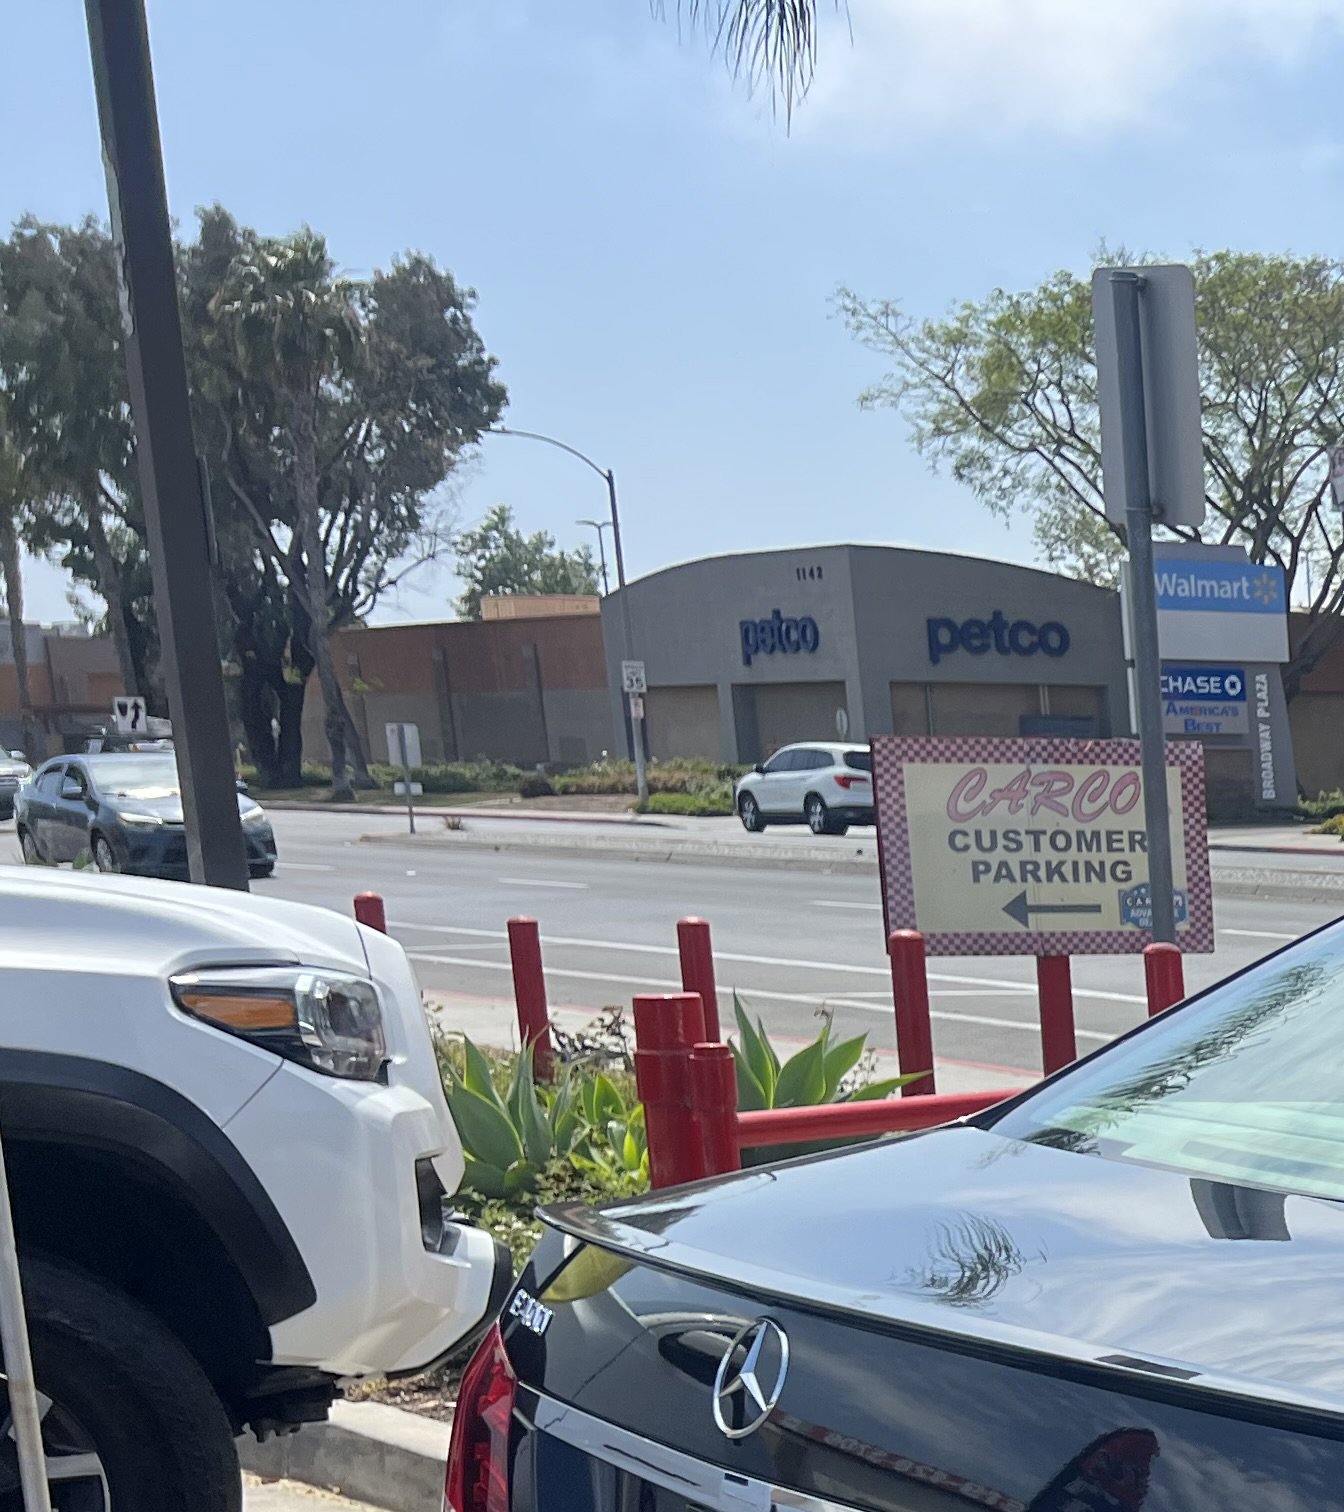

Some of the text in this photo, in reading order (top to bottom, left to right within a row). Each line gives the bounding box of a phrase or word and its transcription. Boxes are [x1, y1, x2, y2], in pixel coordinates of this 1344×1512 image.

[1155, 572, 1250, 600] Walmart
[739, 608, 819, 666] petco
[926, 610, 1070, 665] petco
[1254, 673, 1276, 800] BROADWAY PLAZA
[946, 767, 1142, 822] CARCO
[948, 830, 1147, 852] CUSTOMER
[971, 861, 1132, 883] PARKING
